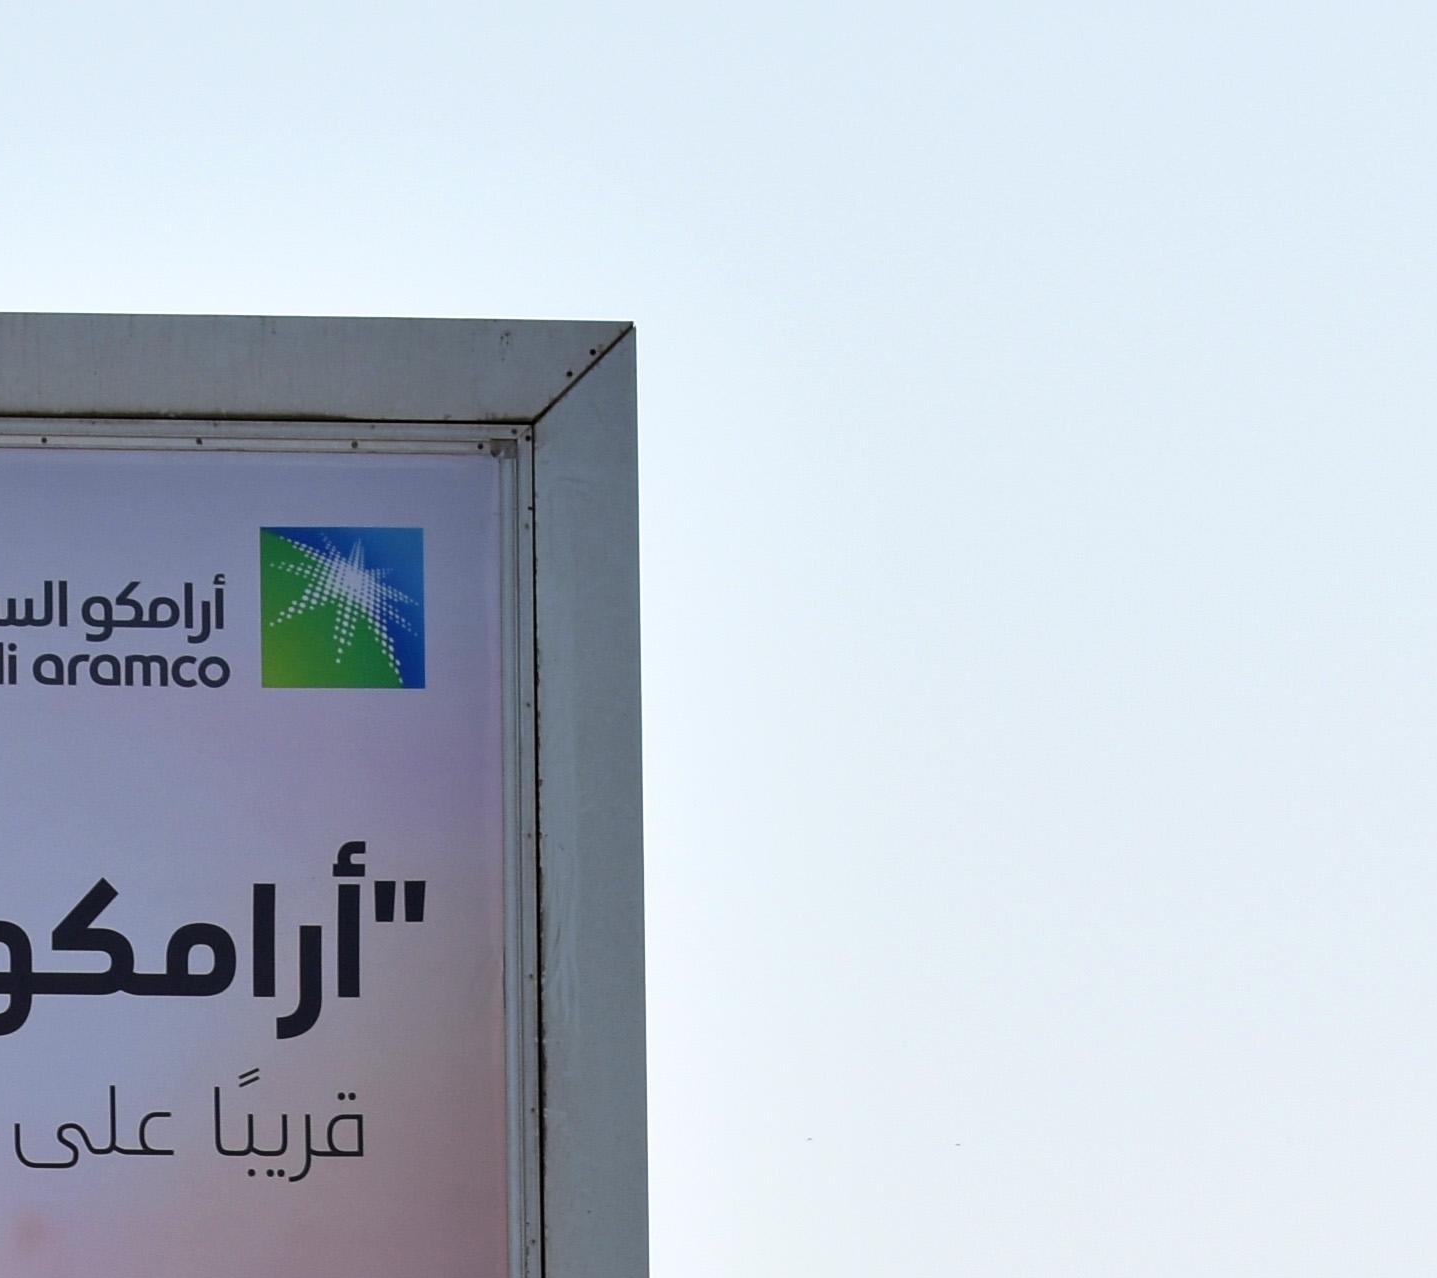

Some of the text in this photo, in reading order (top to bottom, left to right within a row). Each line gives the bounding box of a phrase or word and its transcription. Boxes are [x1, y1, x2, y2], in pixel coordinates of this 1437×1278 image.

[81, 574, 226, 642] أرامكو
[32, 653, 231, 689] aramco
[14, 1084, 175, 1169] على
